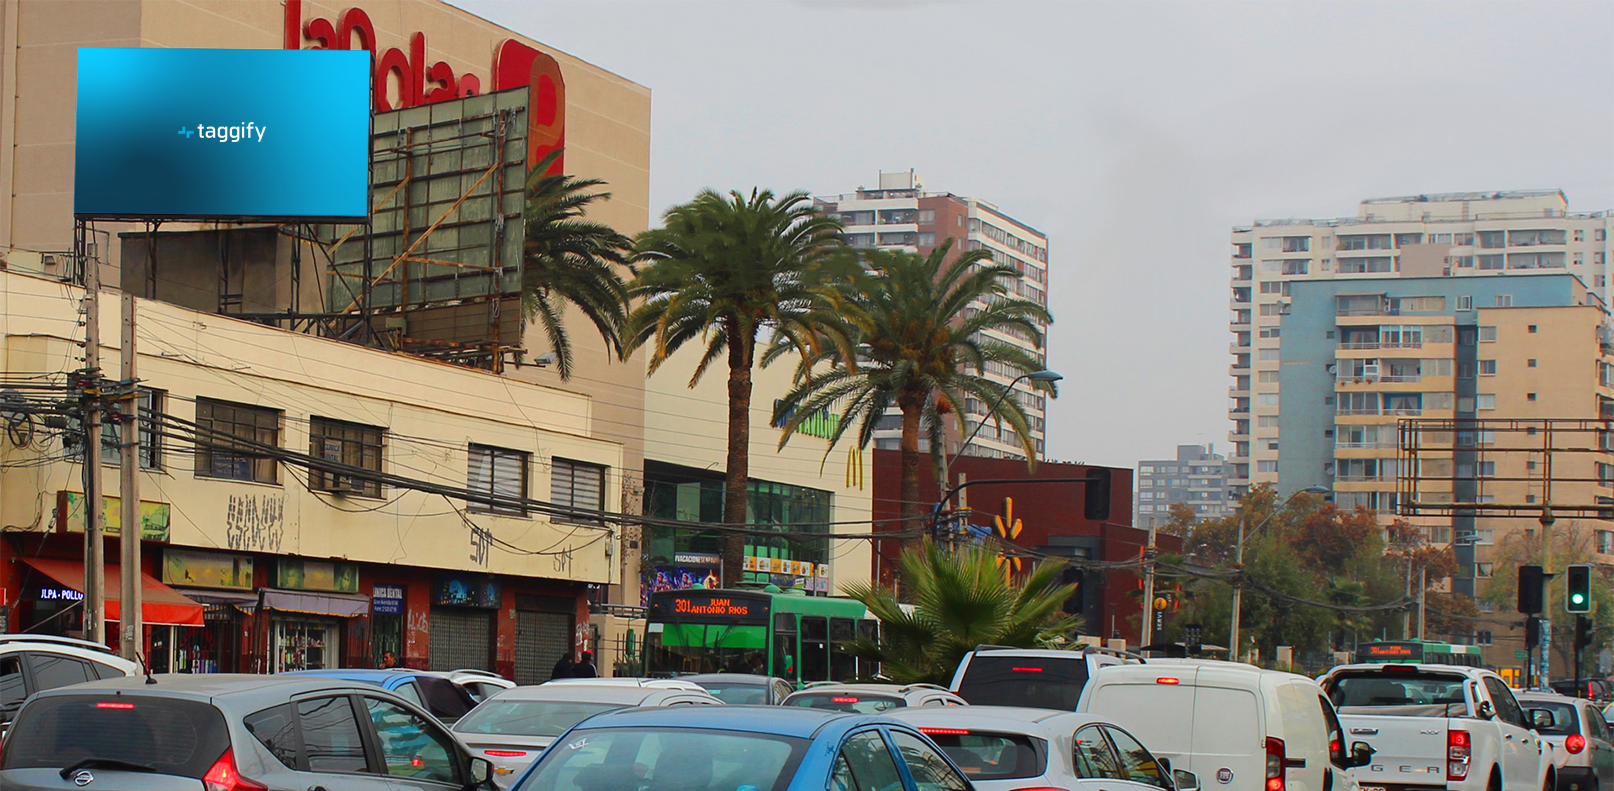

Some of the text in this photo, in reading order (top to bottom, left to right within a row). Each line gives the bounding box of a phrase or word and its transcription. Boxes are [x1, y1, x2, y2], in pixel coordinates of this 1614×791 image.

[197, 121, 266, 142] taggify
[675, 599, 691, 613] 301
[710, 599, 731, 607] JUAN
[691, 606, 748, 615] ANTONIO RIOS
